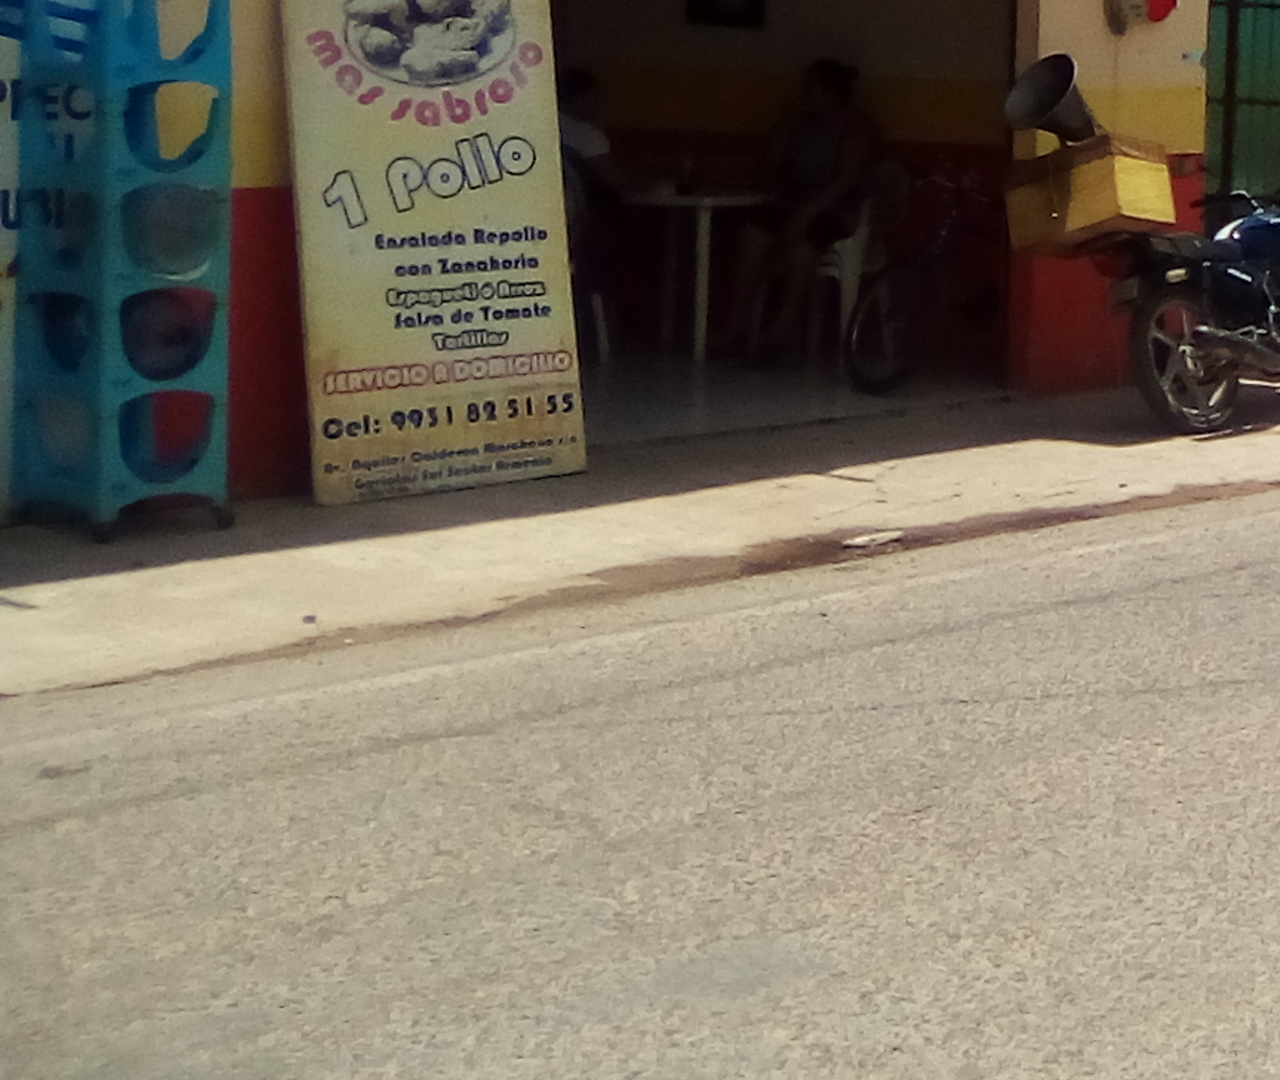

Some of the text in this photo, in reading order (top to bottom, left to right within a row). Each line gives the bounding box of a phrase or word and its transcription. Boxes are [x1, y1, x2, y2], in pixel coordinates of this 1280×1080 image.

[322, 132, 536, 229] 1 Pollo
[375, 226, 548, 250] Ensalada Repollo
[394, 253, 539, 277] con Zanahoria
[386, 282, 478, 308] Espagueti
[497, 279, 546, 299] Arroz
[394, 302, 552, 329] Salsa de Tomate
[432, 329, 510, 351] Tortillas
[323, 350, 573, 395] SERVICIO A DOMICILIO
[322, 414, 381, 440] Cel:
[390, 405, 454, 433] 9931
[466, 401, 498, 424] 82
